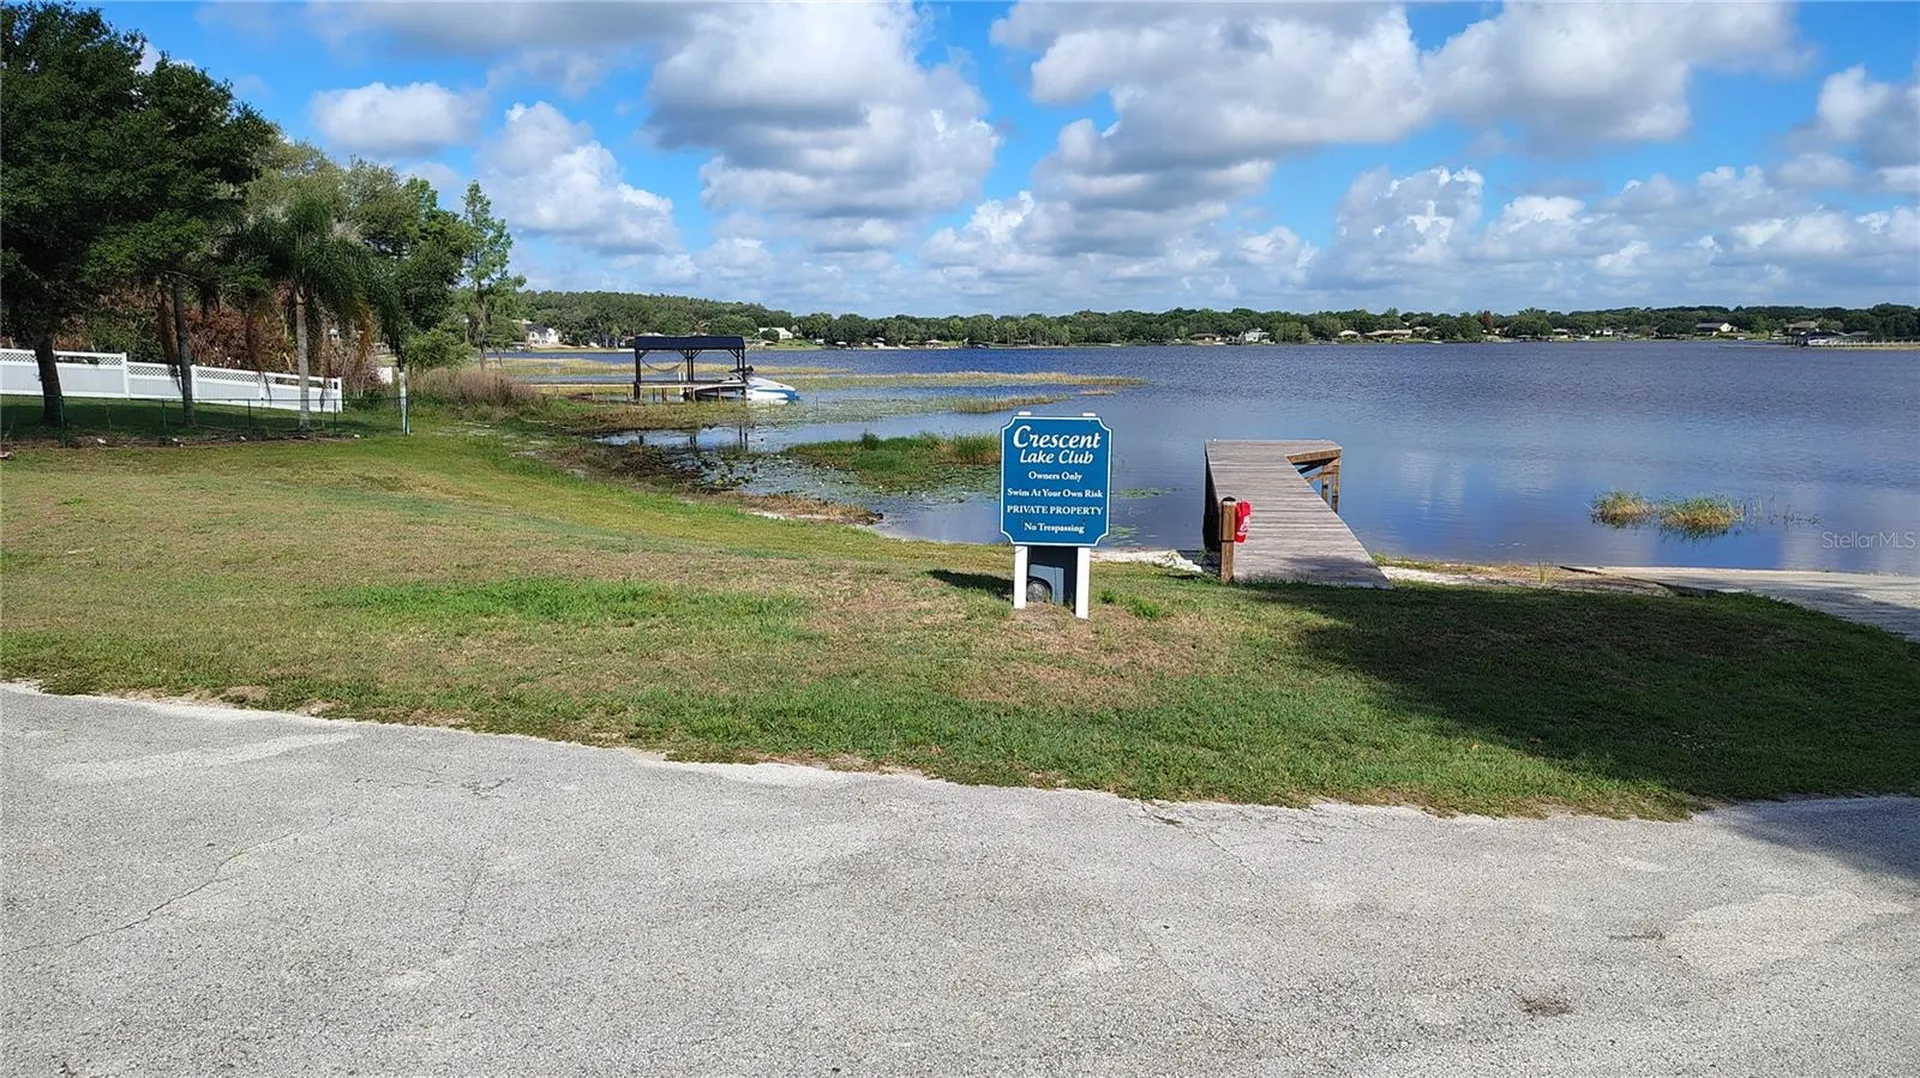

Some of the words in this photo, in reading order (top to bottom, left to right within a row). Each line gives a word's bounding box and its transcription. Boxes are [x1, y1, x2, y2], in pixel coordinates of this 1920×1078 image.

[1013, 425, 1101, 449] Crescent
[1020, 449, 1054, 464] Lake
[1059, 450, 1093, 464] Club
[1029, 471, 1060, 480] Owners
[1062, 472, 1082, 482] Only
[1007, 488, 1030, 497] Swim
[1031, 489, 1041, 497] At
[1042, 489, 1061, 497] Your
[1062, 489, 1083, 498] Own
[1085, 490, 1103, 498] Risk
[1007, 506, 1049, 514] PRIVATE
[1050, 506, 1103, 515] PROPERTY
[1024, 523, 1037, 531] No
[1038, 523, 1085, 534] Trespassing
